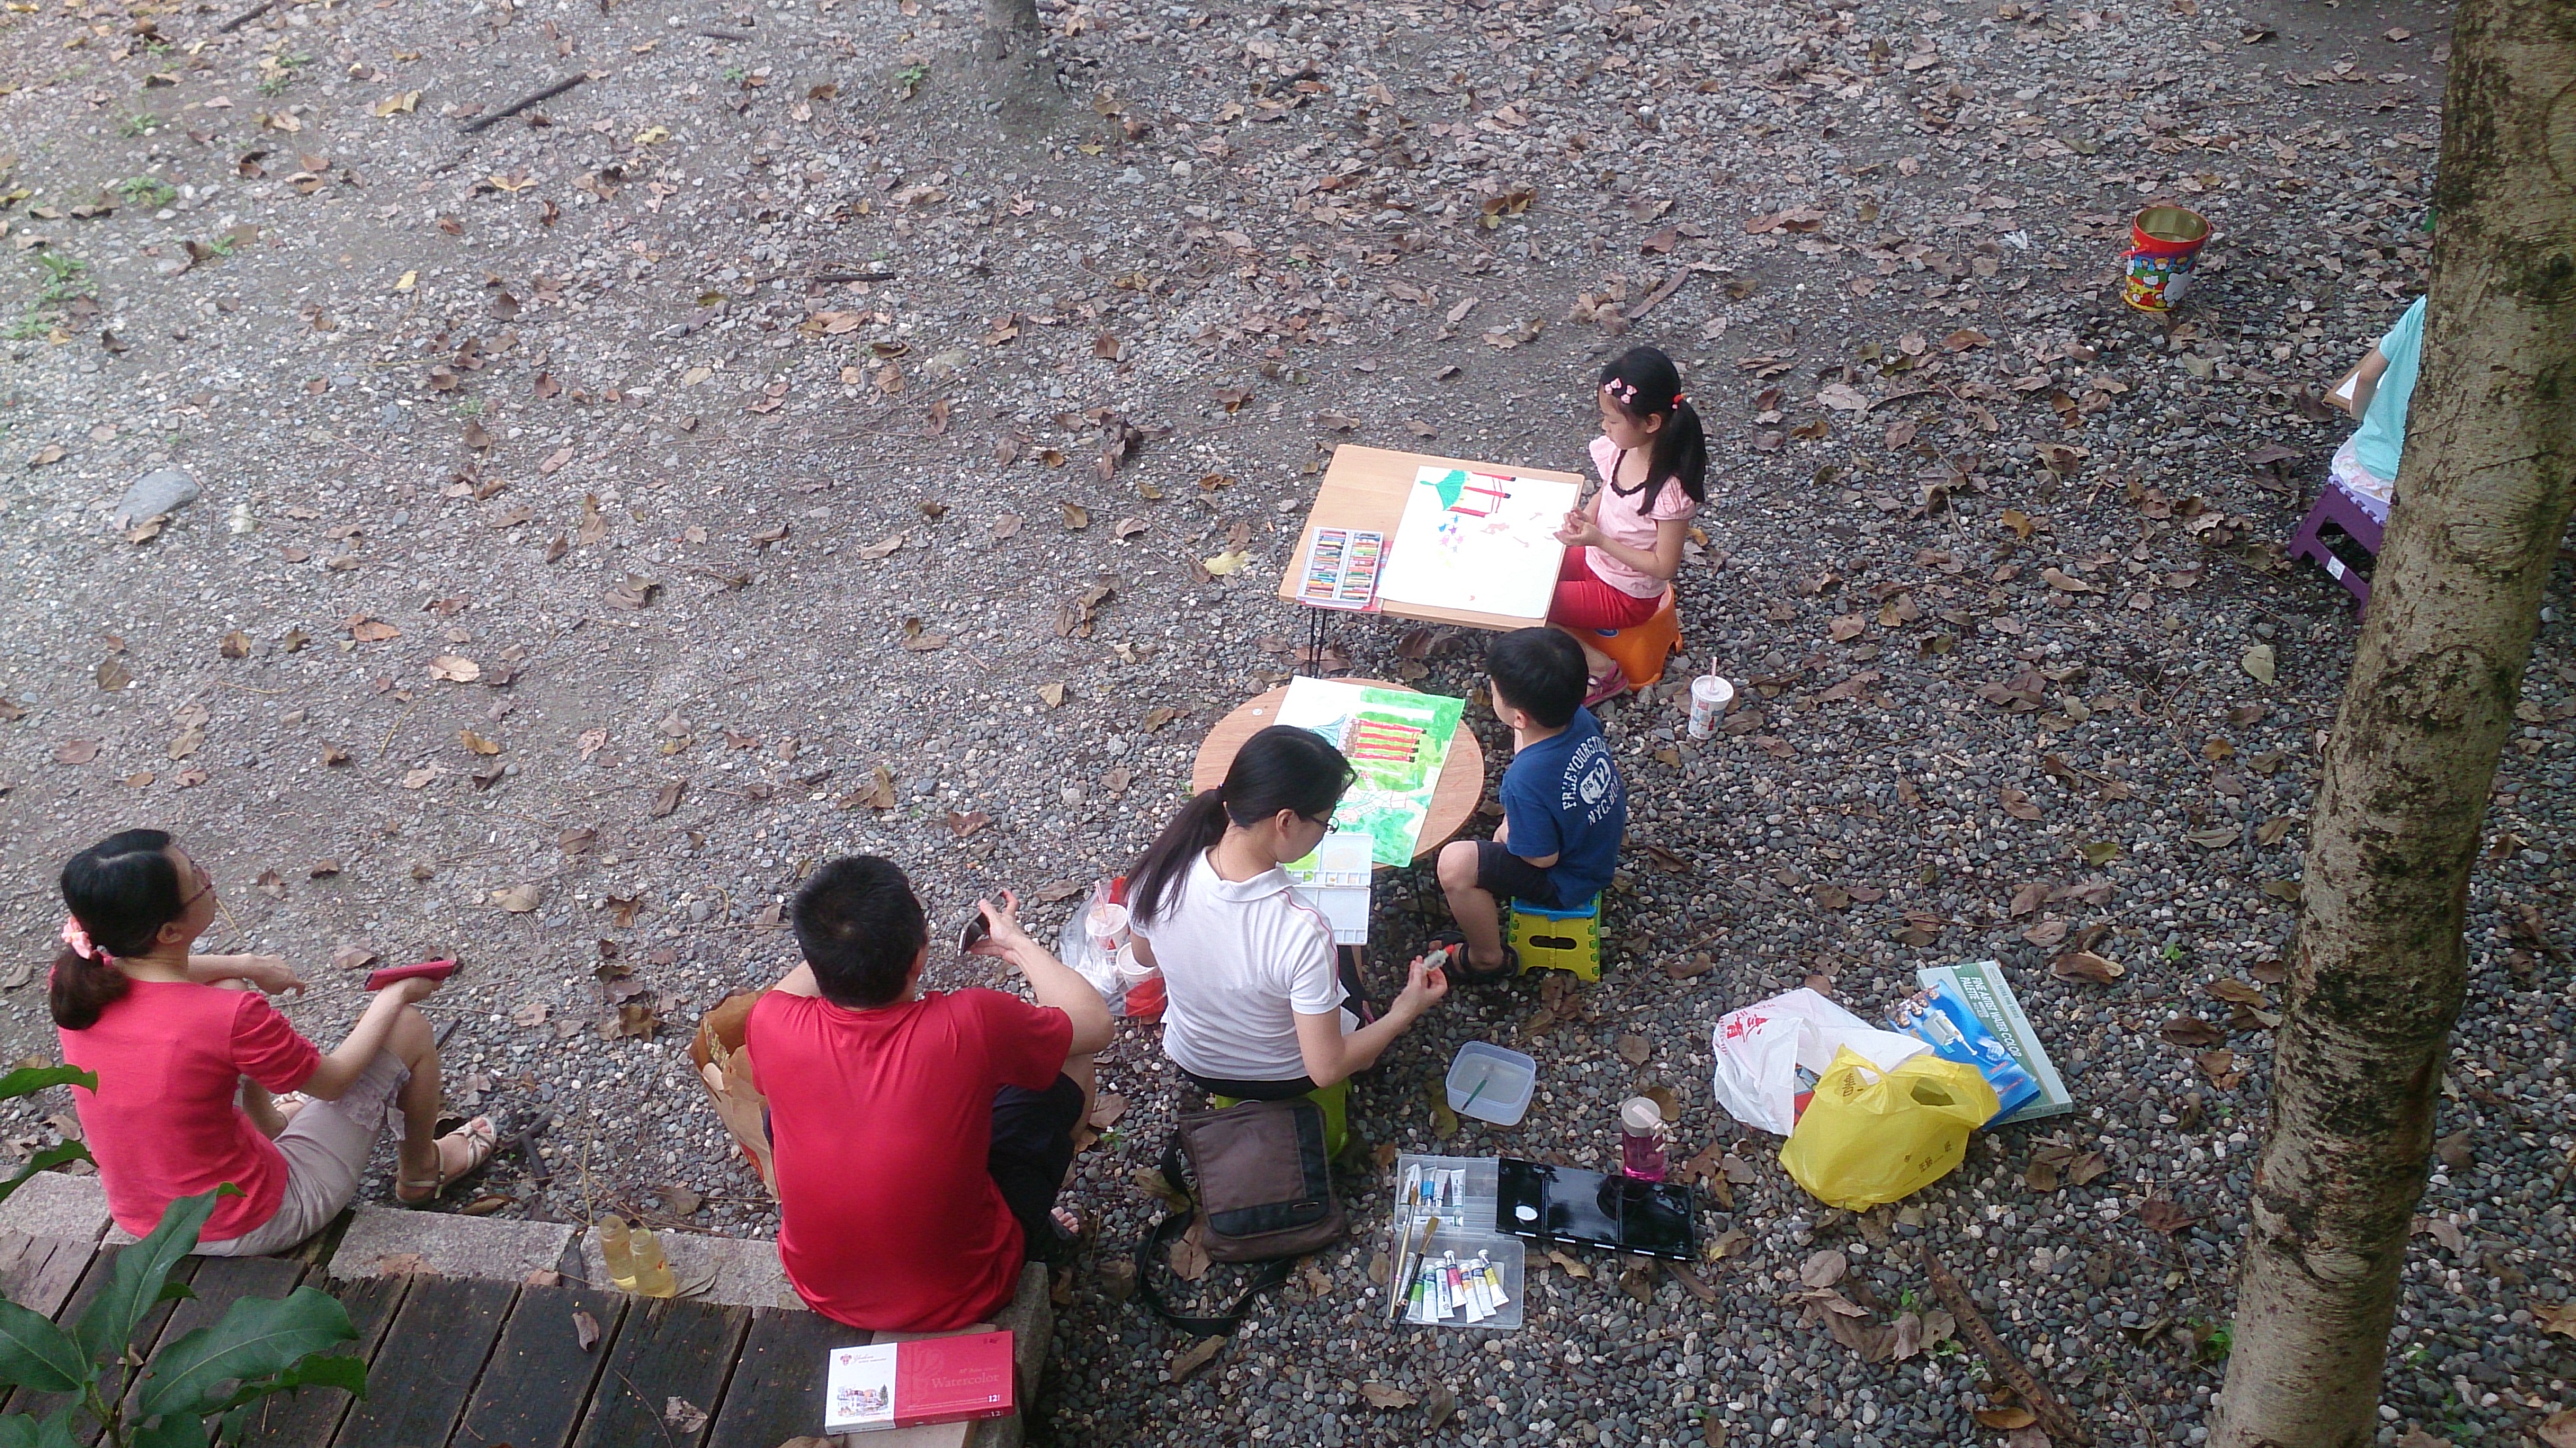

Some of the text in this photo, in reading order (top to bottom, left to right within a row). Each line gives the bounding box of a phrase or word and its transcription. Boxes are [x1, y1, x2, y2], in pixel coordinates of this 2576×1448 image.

[1960, 977, 1980, 1000] PALETTE
[1971, 977, 1987, 991] FINE
[1978, 991, 1998, 1012] ARTIST
[1989, 1010, 2008, 1032] WATER
[2001, 1032, 2022, 1057] COLOR
[931, 1372, 999, 1388] Watercolor
